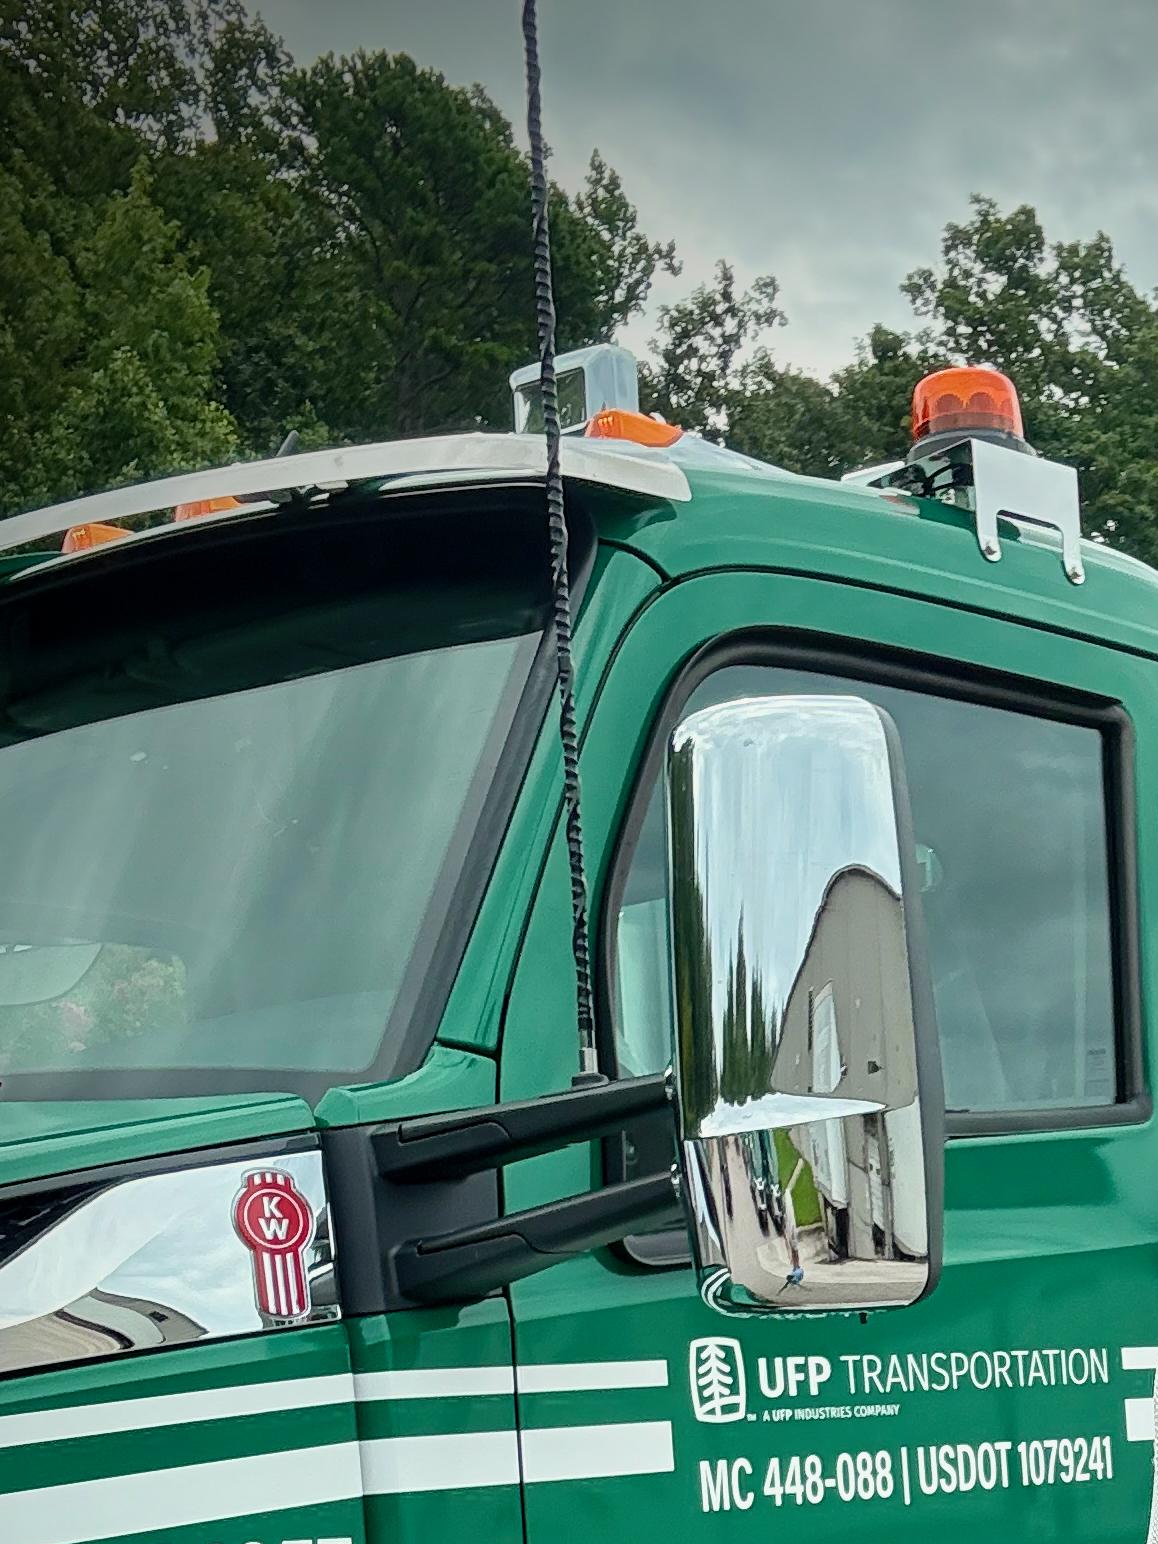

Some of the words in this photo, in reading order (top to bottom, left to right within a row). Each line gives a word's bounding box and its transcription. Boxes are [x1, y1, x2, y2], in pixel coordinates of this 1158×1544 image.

[757, 1355, 832, 1399] UFP
[839, 1347, 1109, 1395] TRANSPORTATION
[762, 1409, 771, 1422] A
[772, 1407, 793, 1422] UFP
[794, 1405, 851, 1421] INDUSTRIES
[853, 1403, 900, 1418] COMPANY
[699, 1456, 755, 1513] MC
[763, 1449, 894, 1507] 448-088
[916, 1441, 1012, 1496] USDOT
[1017, 1435, 1113, 1487] 1079241
